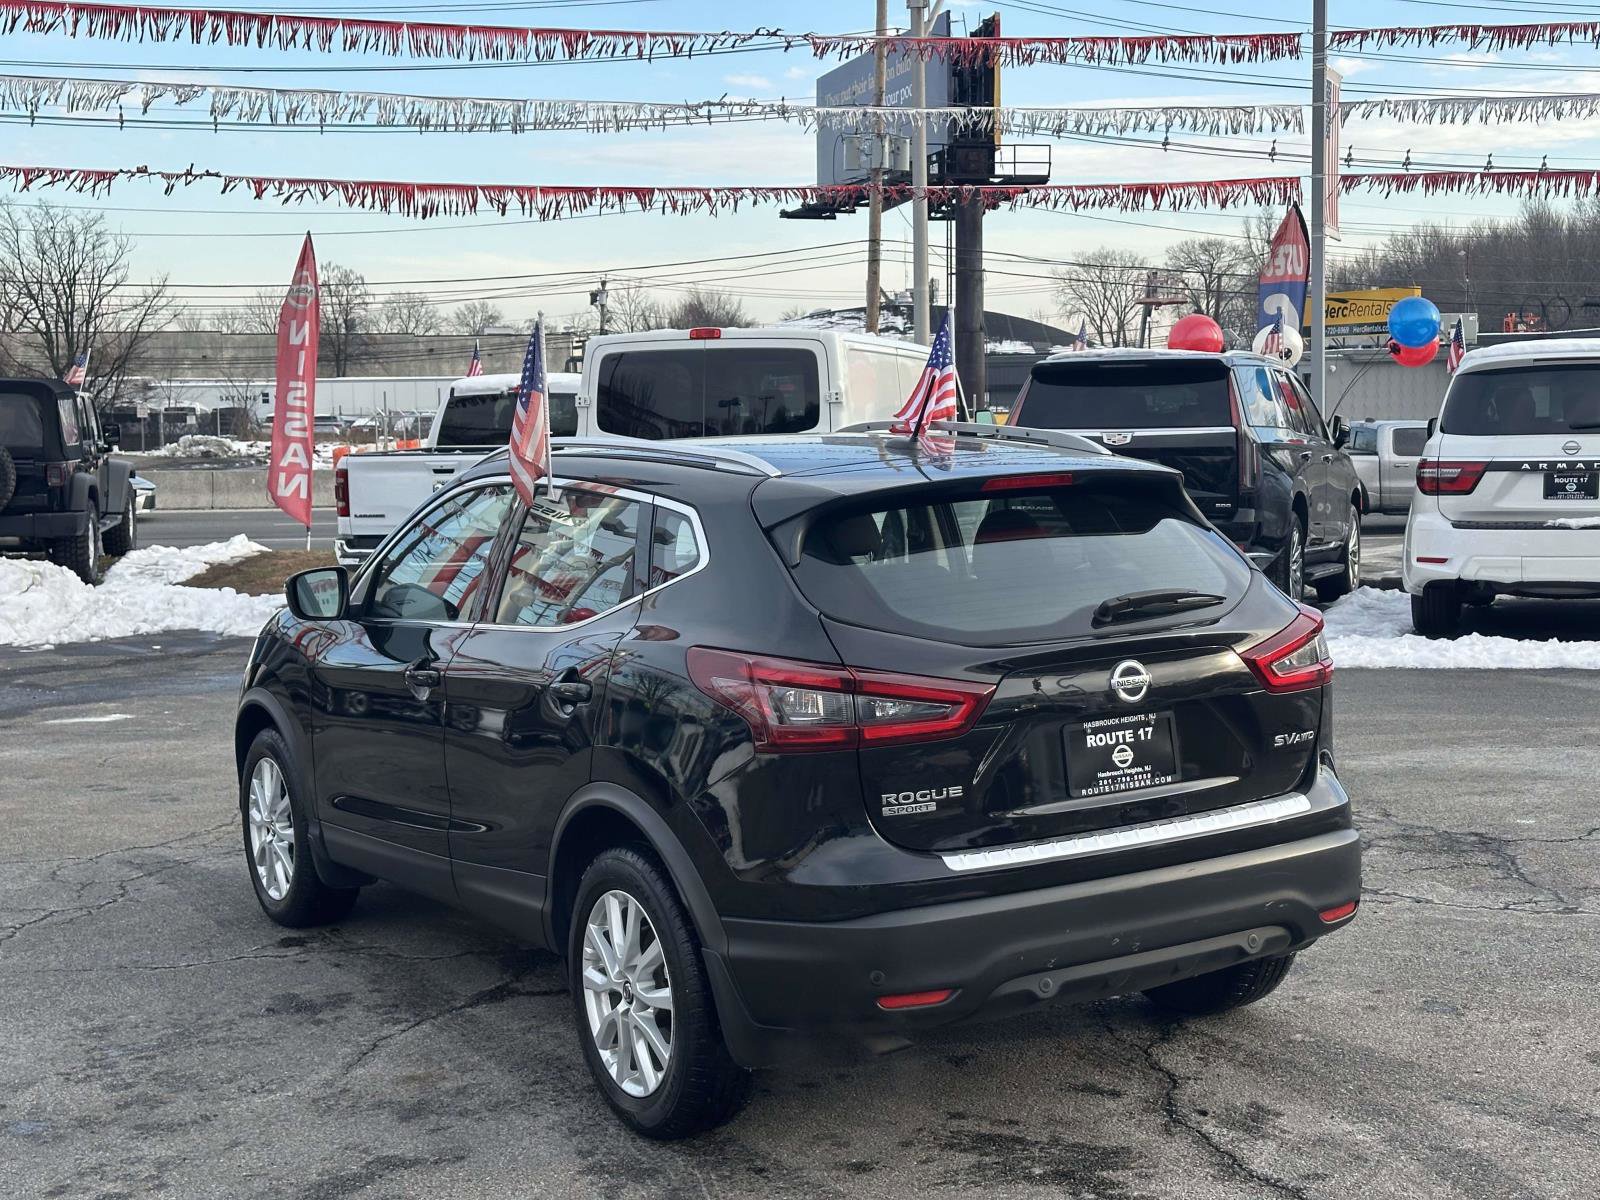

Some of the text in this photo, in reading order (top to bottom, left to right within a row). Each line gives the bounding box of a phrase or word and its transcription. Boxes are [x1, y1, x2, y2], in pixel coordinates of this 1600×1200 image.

[1352, 324, 1389, 334] HercRentals.co
[1116, 675, 1149, 687] NISSAN
[1083, 717, 1120, 729] HASBROUCK
[1149, 712, 1157, 720] NJ
[1086, 727, 1153, 748] ROUTE 17
[1097, 770, 1124, 778] Hasbrouck
[1144, 764, 1152, 772] NJ
[1081, 775, 1172, 796] ROUTE17NISSAN.COM
[881, 785, 963, 804] ROGUE
[888, 803, 932, 815] SPORT
